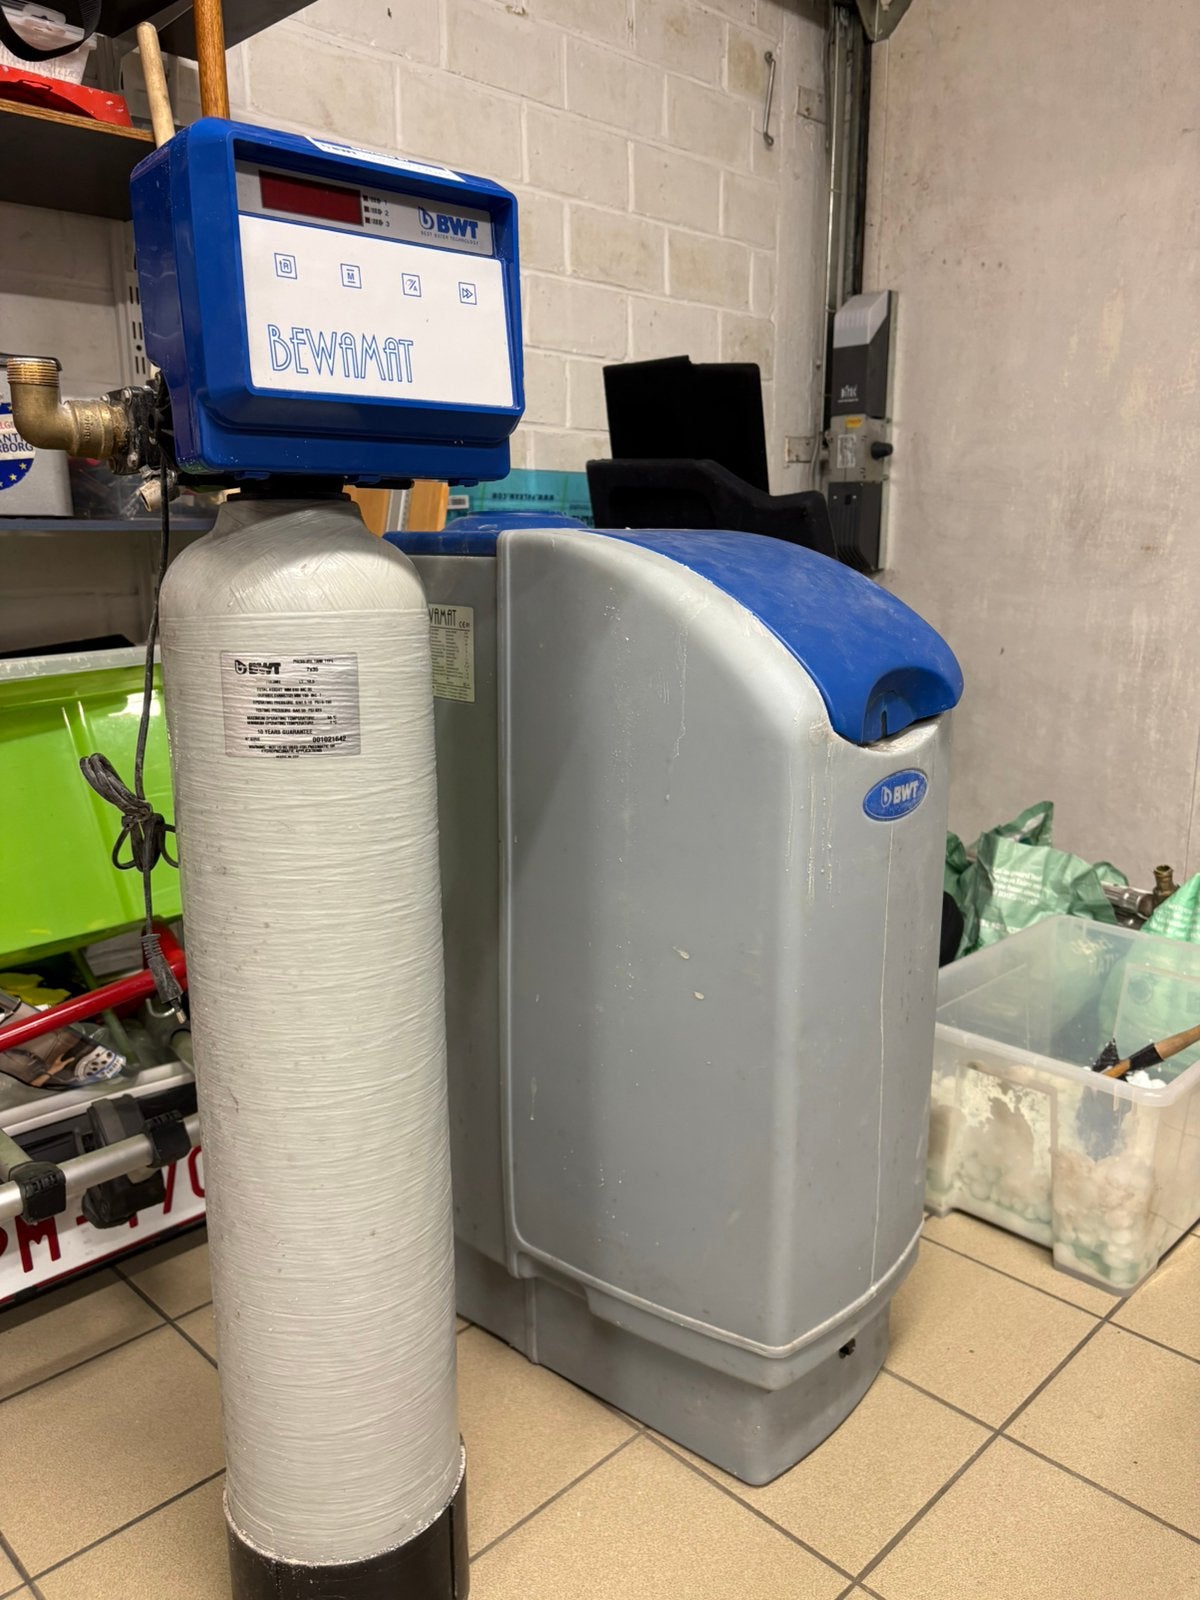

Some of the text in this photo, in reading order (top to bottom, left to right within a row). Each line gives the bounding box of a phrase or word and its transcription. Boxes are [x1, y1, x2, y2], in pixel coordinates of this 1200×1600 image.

[436, 214, 478, 239] BWT
[450, 236, 479, 246] TECHNOLOGY
[267, 323, 414, 383] BEWAMAT
[248, 662, 281, 675] BWT
[893, 780, 919, 805] BWT
